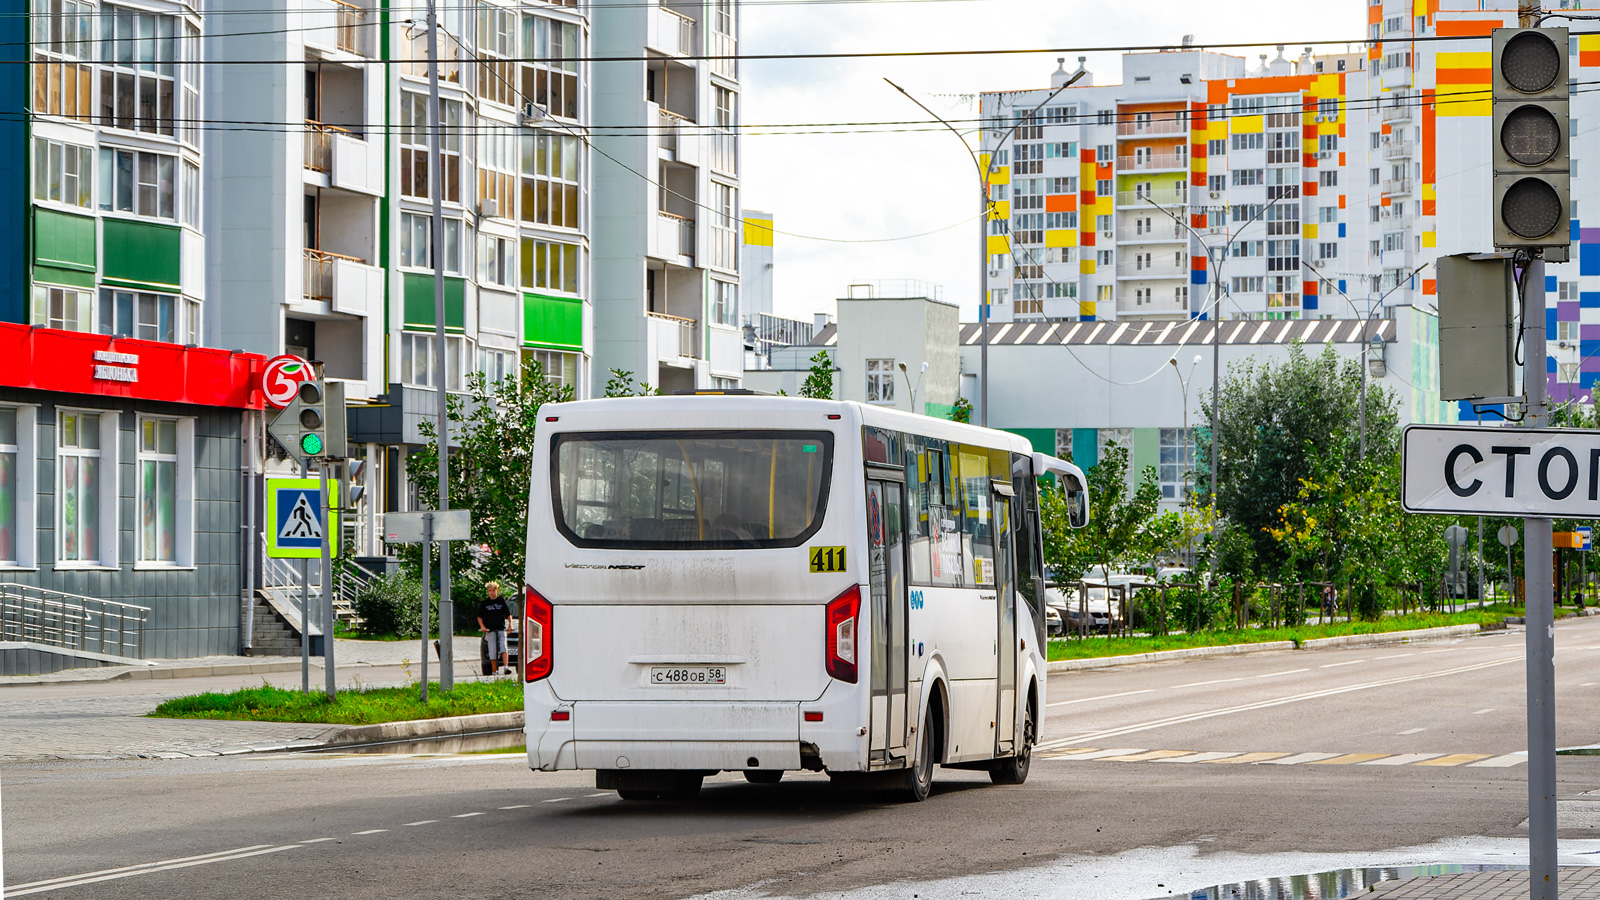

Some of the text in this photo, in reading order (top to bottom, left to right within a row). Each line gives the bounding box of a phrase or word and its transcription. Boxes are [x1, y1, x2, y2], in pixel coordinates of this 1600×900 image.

[94, 365, 138, 382] ЯБЛОНЬКА
[271, 372, 299, 402] 5
[811, 547, 846, 572] 411
